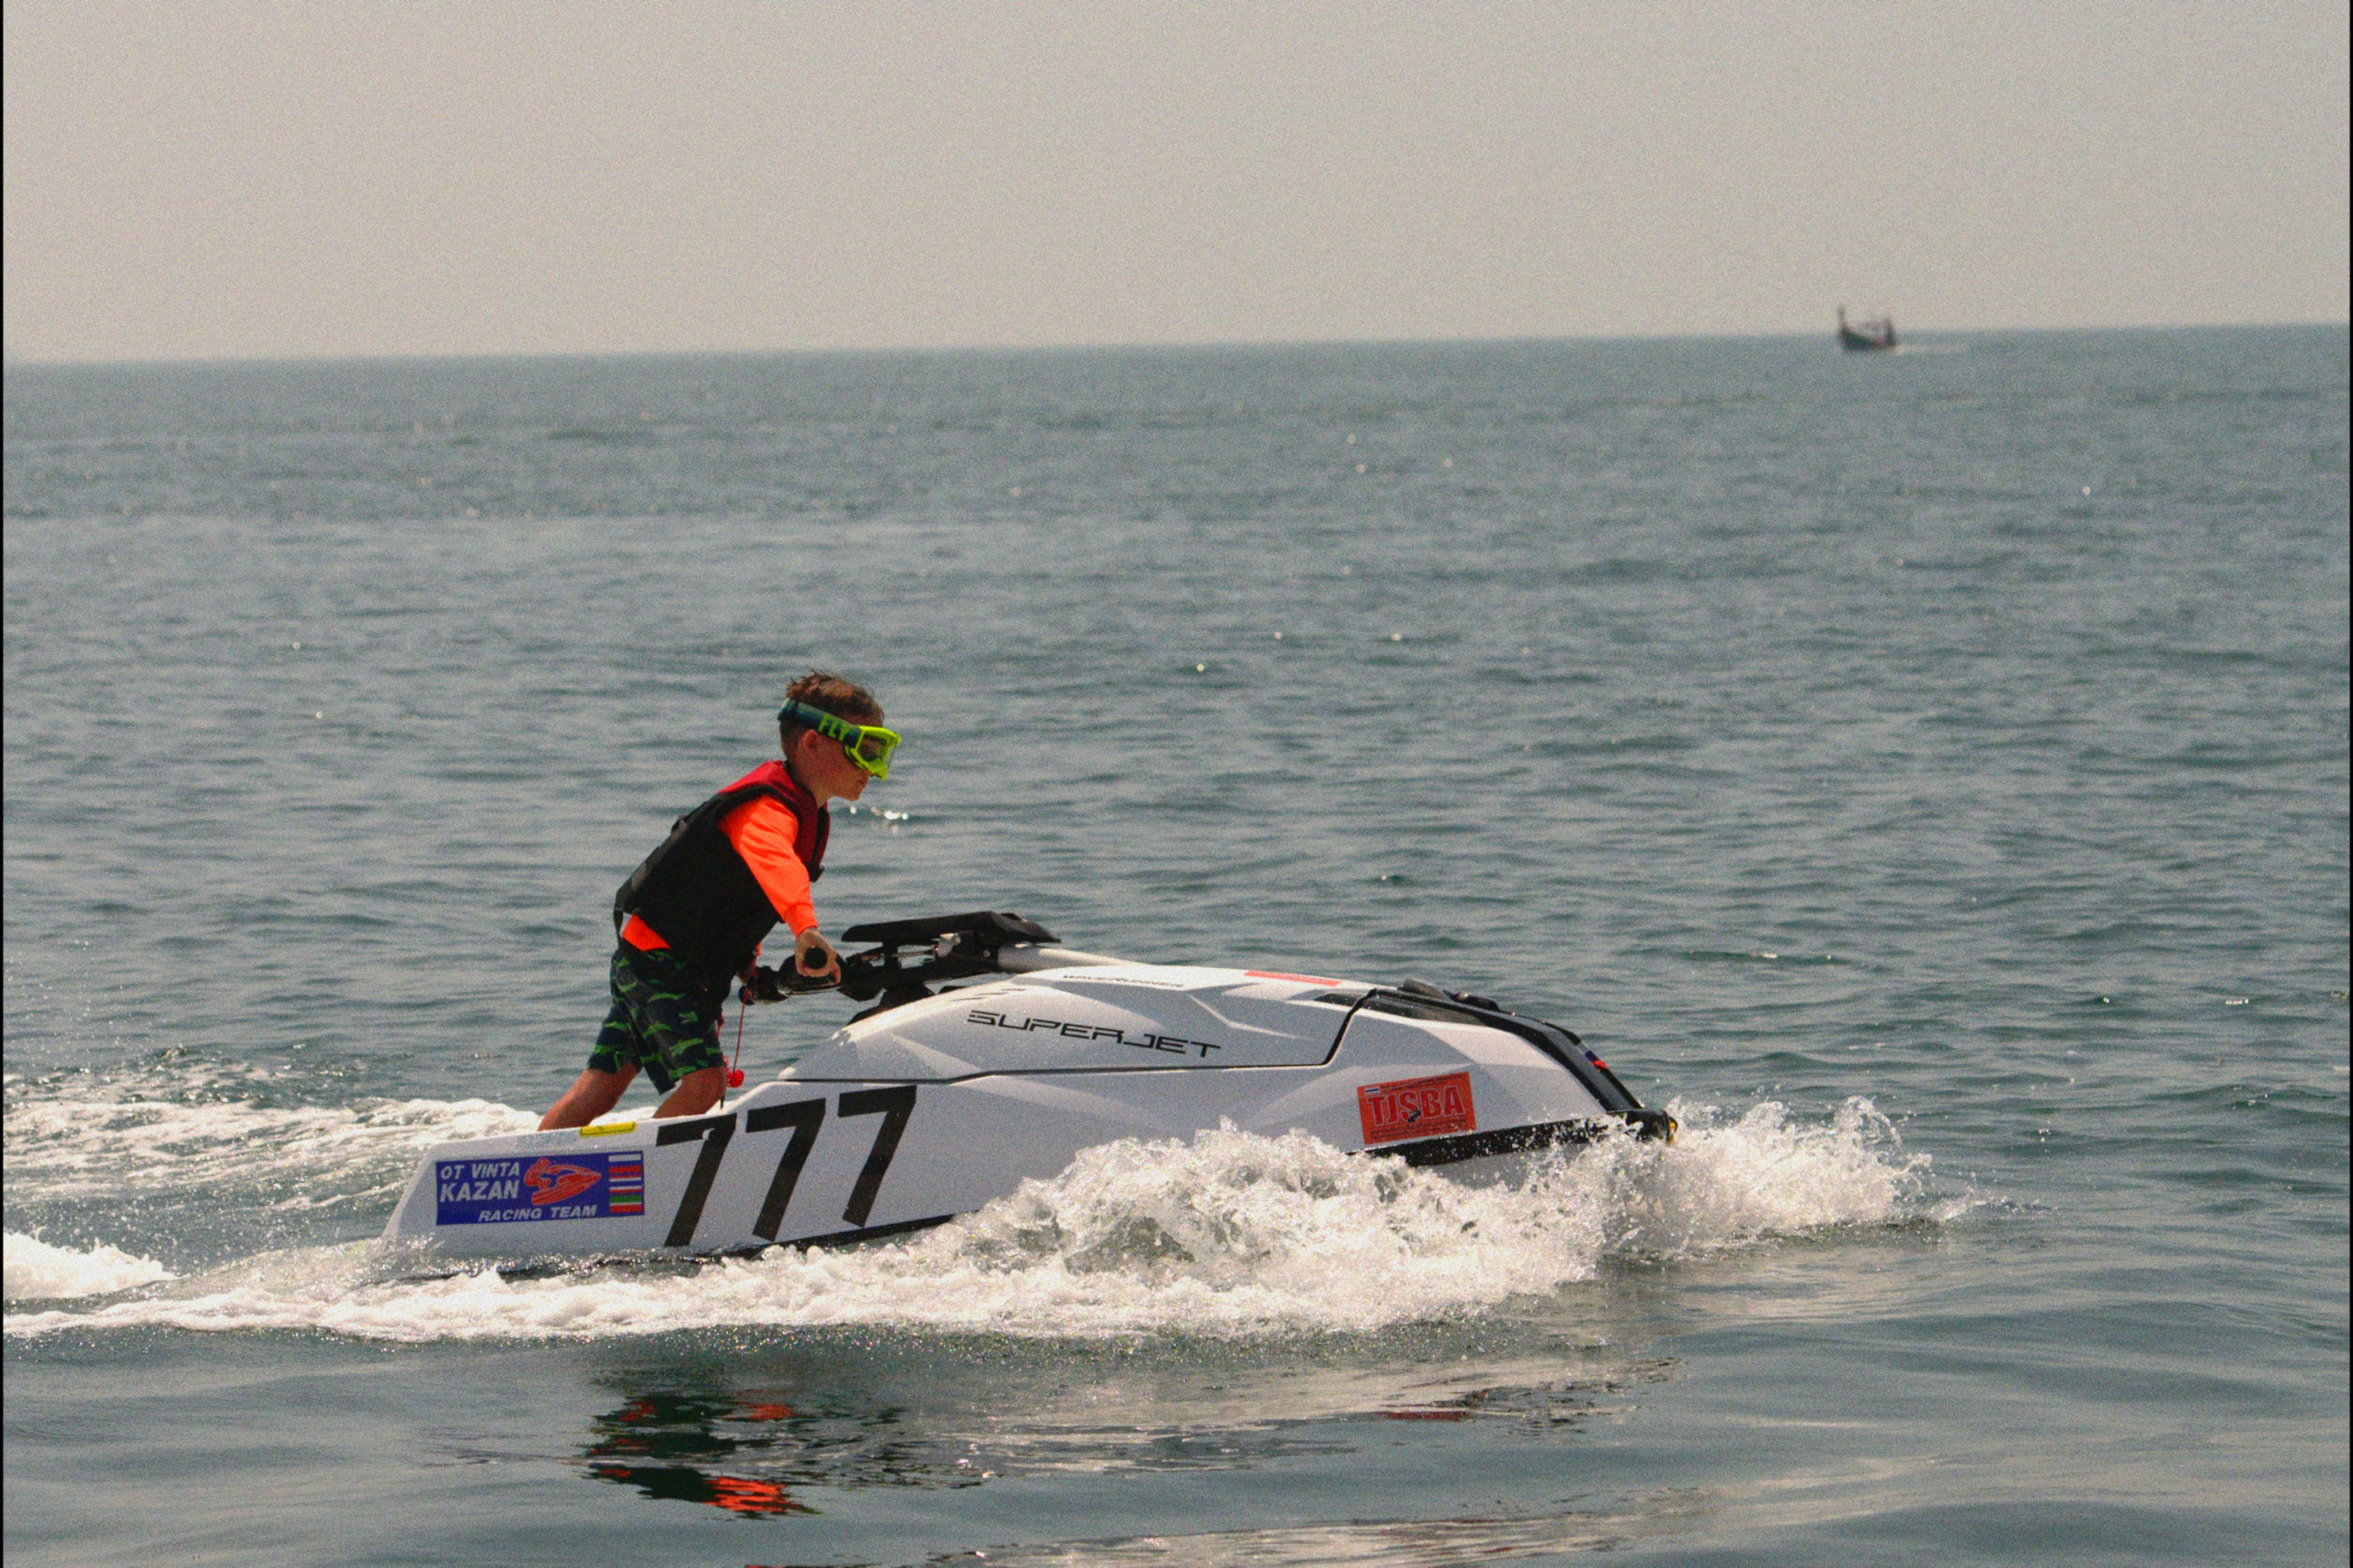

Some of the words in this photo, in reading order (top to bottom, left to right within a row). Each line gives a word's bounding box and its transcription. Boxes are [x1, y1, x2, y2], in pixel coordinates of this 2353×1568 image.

[818, 713, 854, 742] FLY
[967, 1009, 1222, 1059] SUPERJET
[1367, 1084, 1468, 1127] TJSBA
[439, 1165, 464, 1181] OT
[471, 1162, 521, 1178] VINTA
[655, 1085, 917, 1247] 777
[439, 1180, 520, 1203] KAZAN
[478, 1207, 542, 1223] RACING
[551, 1205, 597, 1220] TEAM
